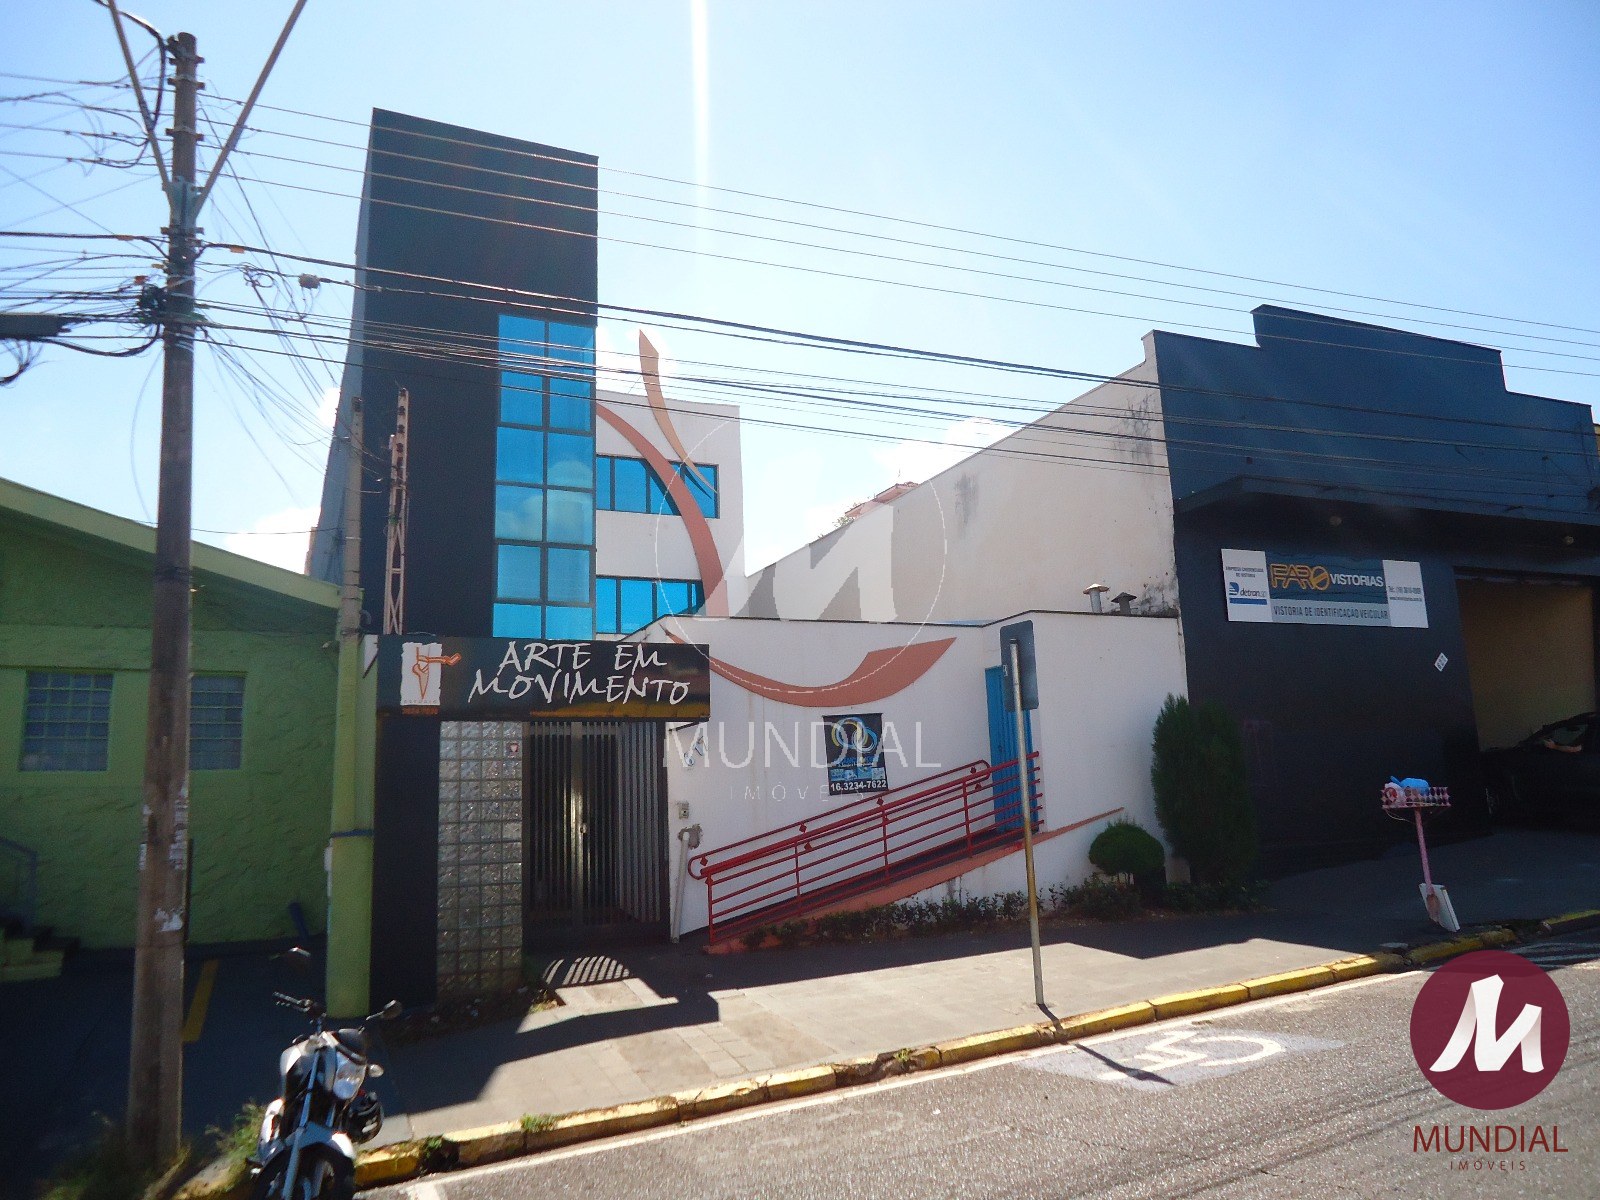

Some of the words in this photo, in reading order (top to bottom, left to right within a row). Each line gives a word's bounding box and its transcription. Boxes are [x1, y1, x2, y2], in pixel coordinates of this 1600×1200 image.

[1330, 573, 1384, 587] VISTORIAS
[1273, 606, 1303, 616] VISTORIA
[1304, 607, 1313, 616] DE
[1360, 609, 1388, 619] VEICULAR
[497, 641, 591, 675] ARTE
[615, 644, 667, 675] EM
[468, 669, 690, 704] MOVIMENTO
[830, 780, 887, 792] 16.3234-7622
